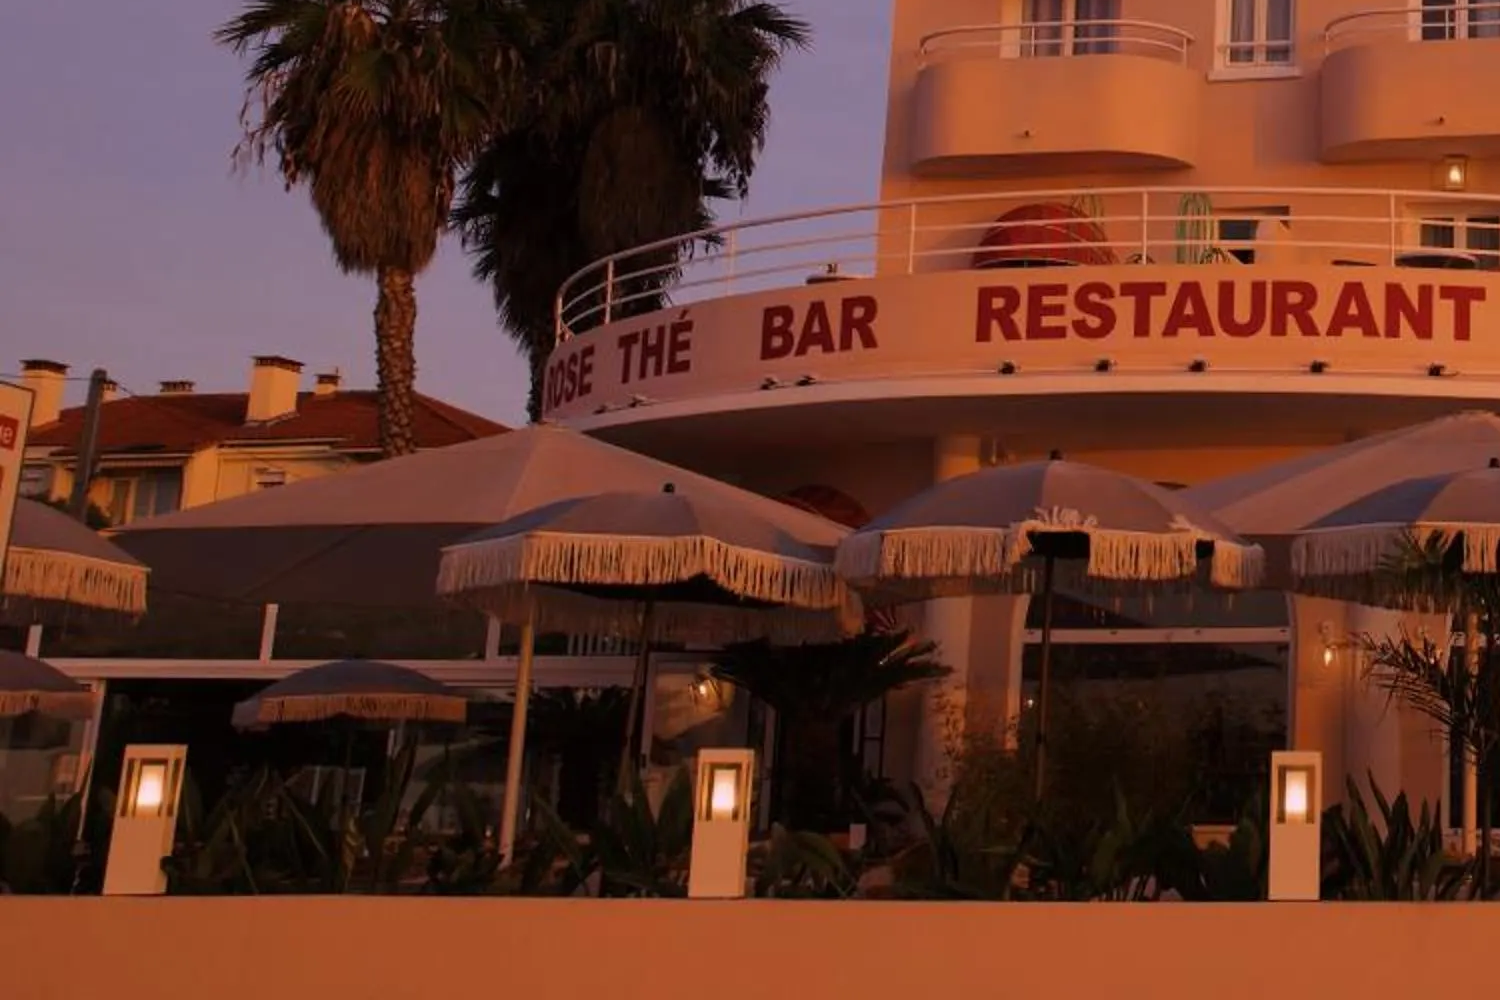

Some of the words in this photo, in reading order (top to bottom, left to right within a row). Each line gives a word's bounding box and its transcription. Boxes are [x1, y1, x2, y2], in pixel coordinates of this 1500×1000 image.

[618, 309, 693, 384] THÉ
[760, 296, 878, 360] BAR
[976, 280, 1486, 342] RESTAURANT
